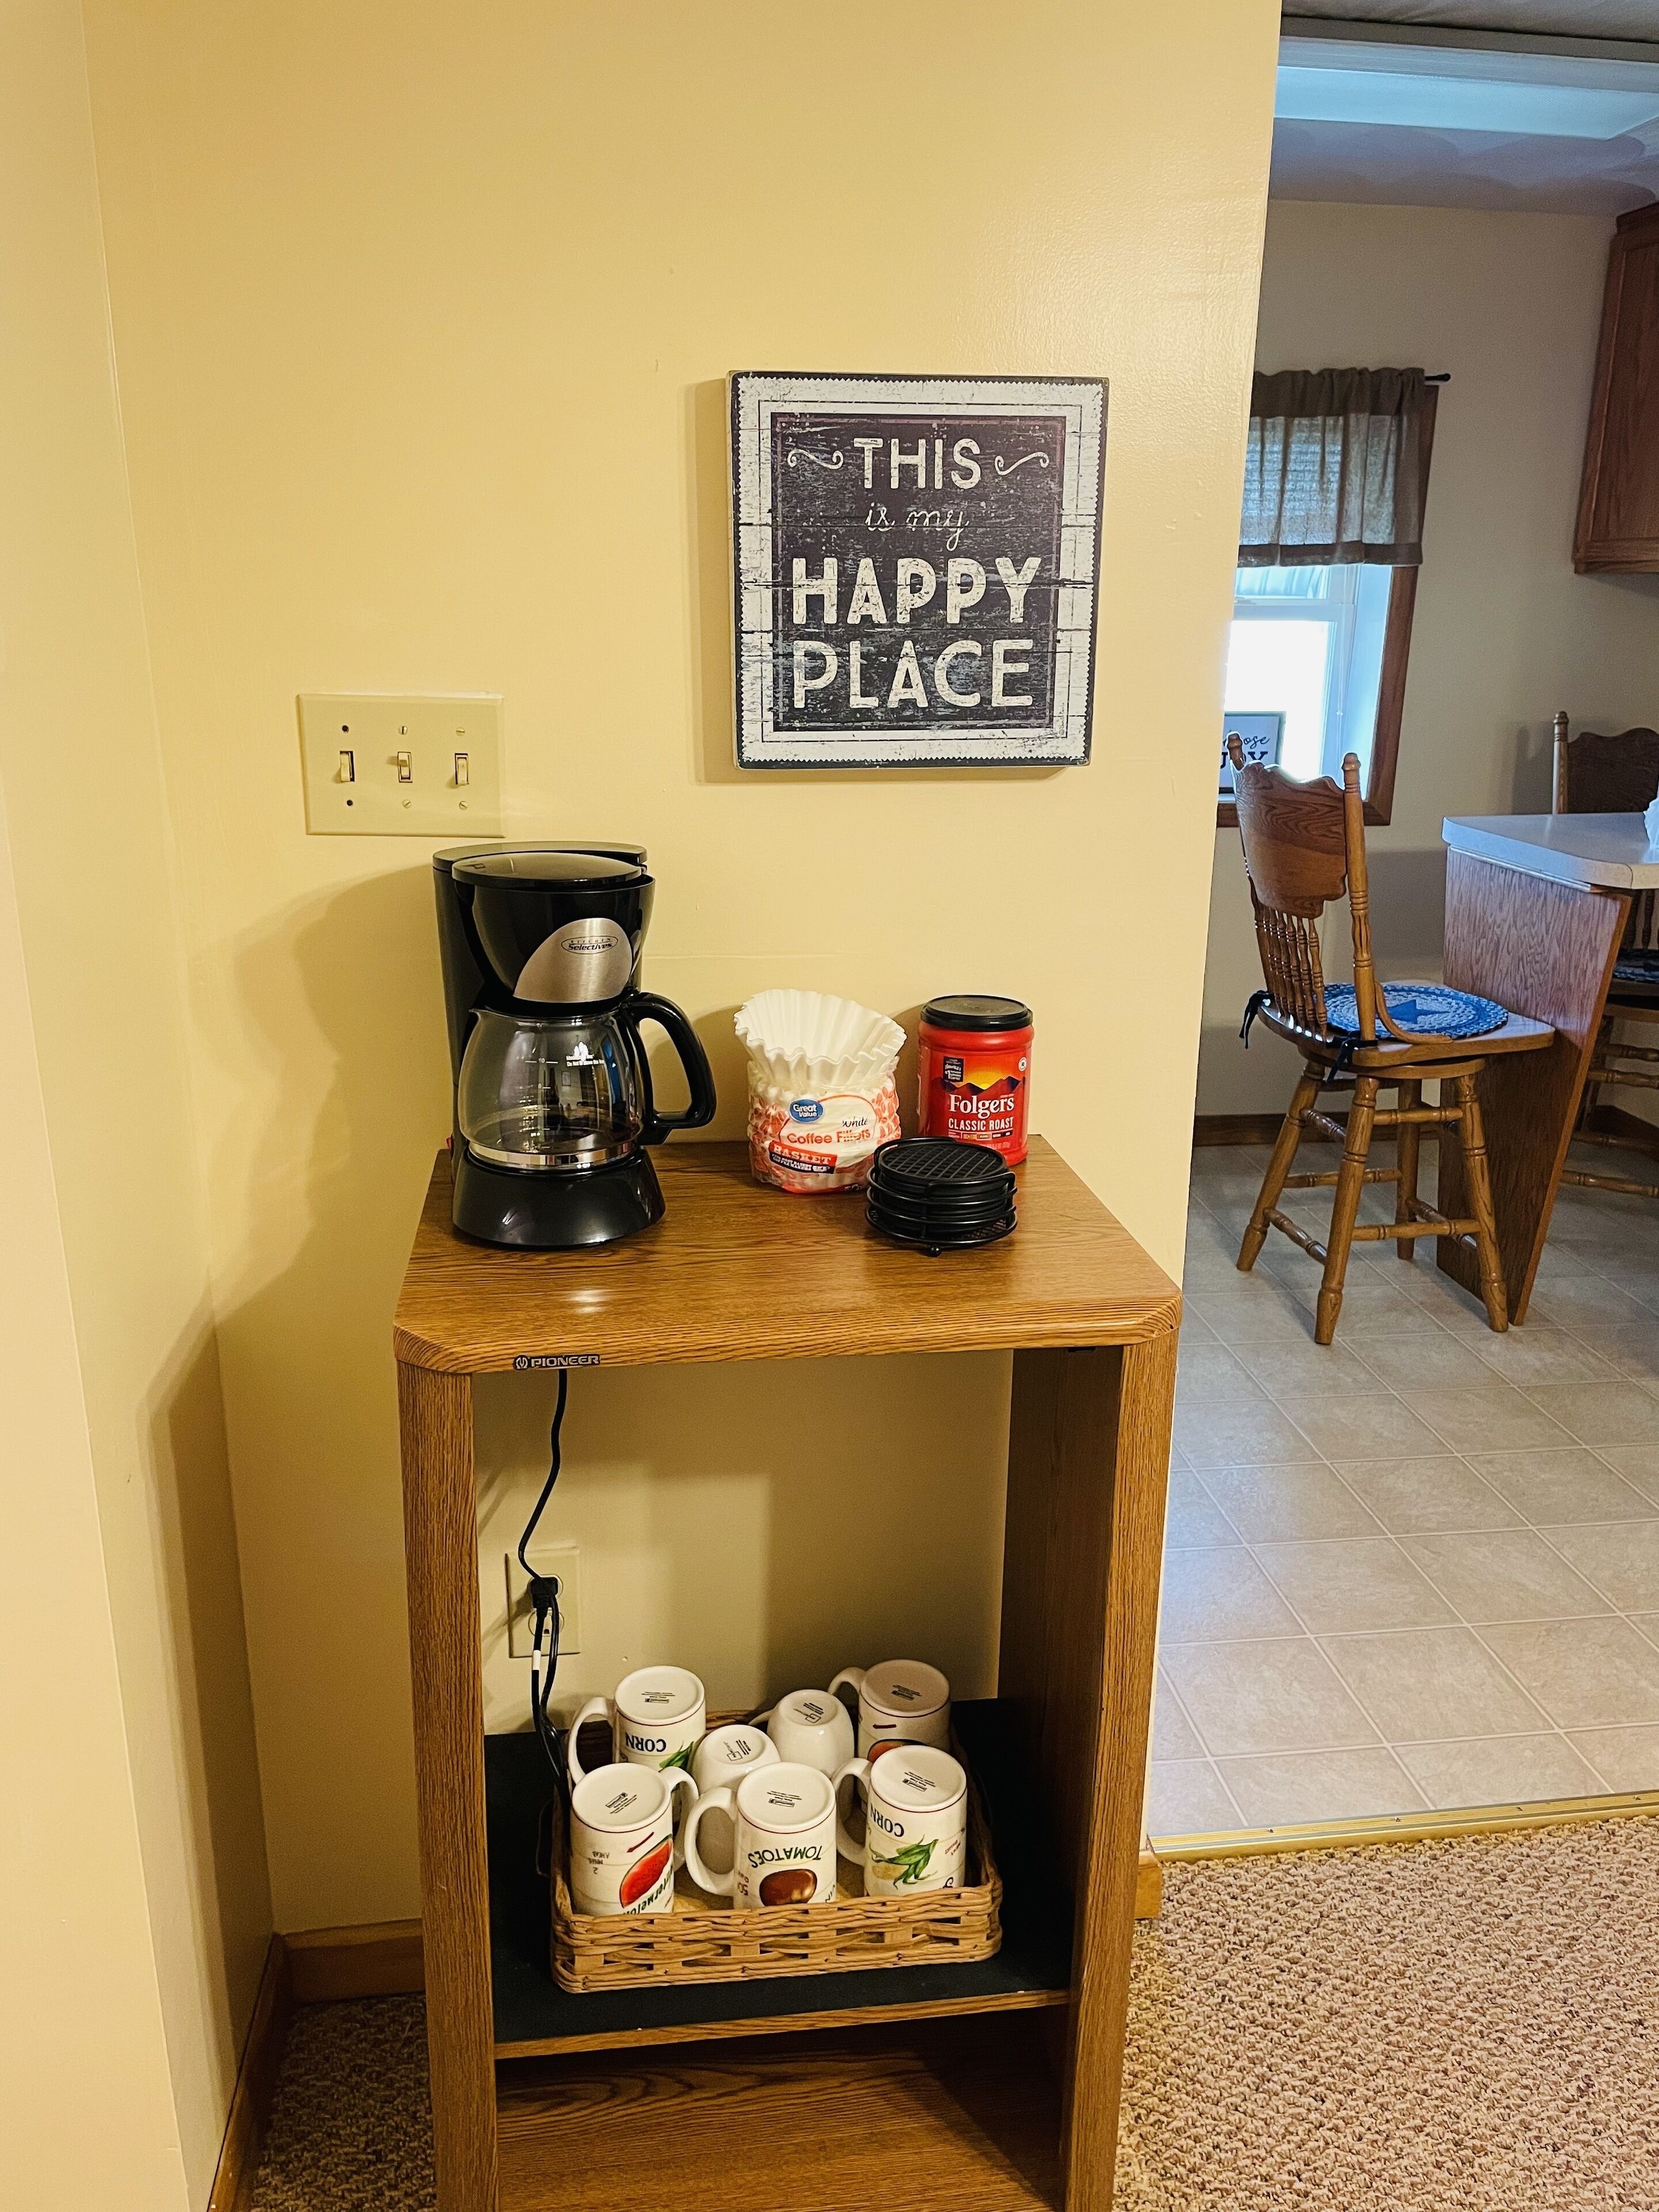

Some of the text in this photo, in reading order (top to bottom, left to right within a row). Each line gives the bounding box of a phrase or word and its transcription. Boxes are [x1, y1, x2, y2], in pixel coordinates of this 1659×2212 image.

[853, 438, 981, 490] THIS
[864, 502, 970, 551] is my
[791, 556, 1041, 625] HAPPY
[792, 639, 1033, 709] PLACE
[793, 1104, 817, 1112] Great
[949, 1094, 1014, 1119] Folgers
[948, 1116, 1014, 1131] CLASSIC ROAST
[787, 1132, 832, 1144] Coffee
[773, 1143, 832, 1165] BASKET
[531, 1355, 599, 1368] PIONEER
[625, 1732, 666, 1752] CORN
[870, 1803, 905, 1838] CORN
[747, 1845, 823, 1868] TOMATOES
[593, 1866, 598, 1874] 2
